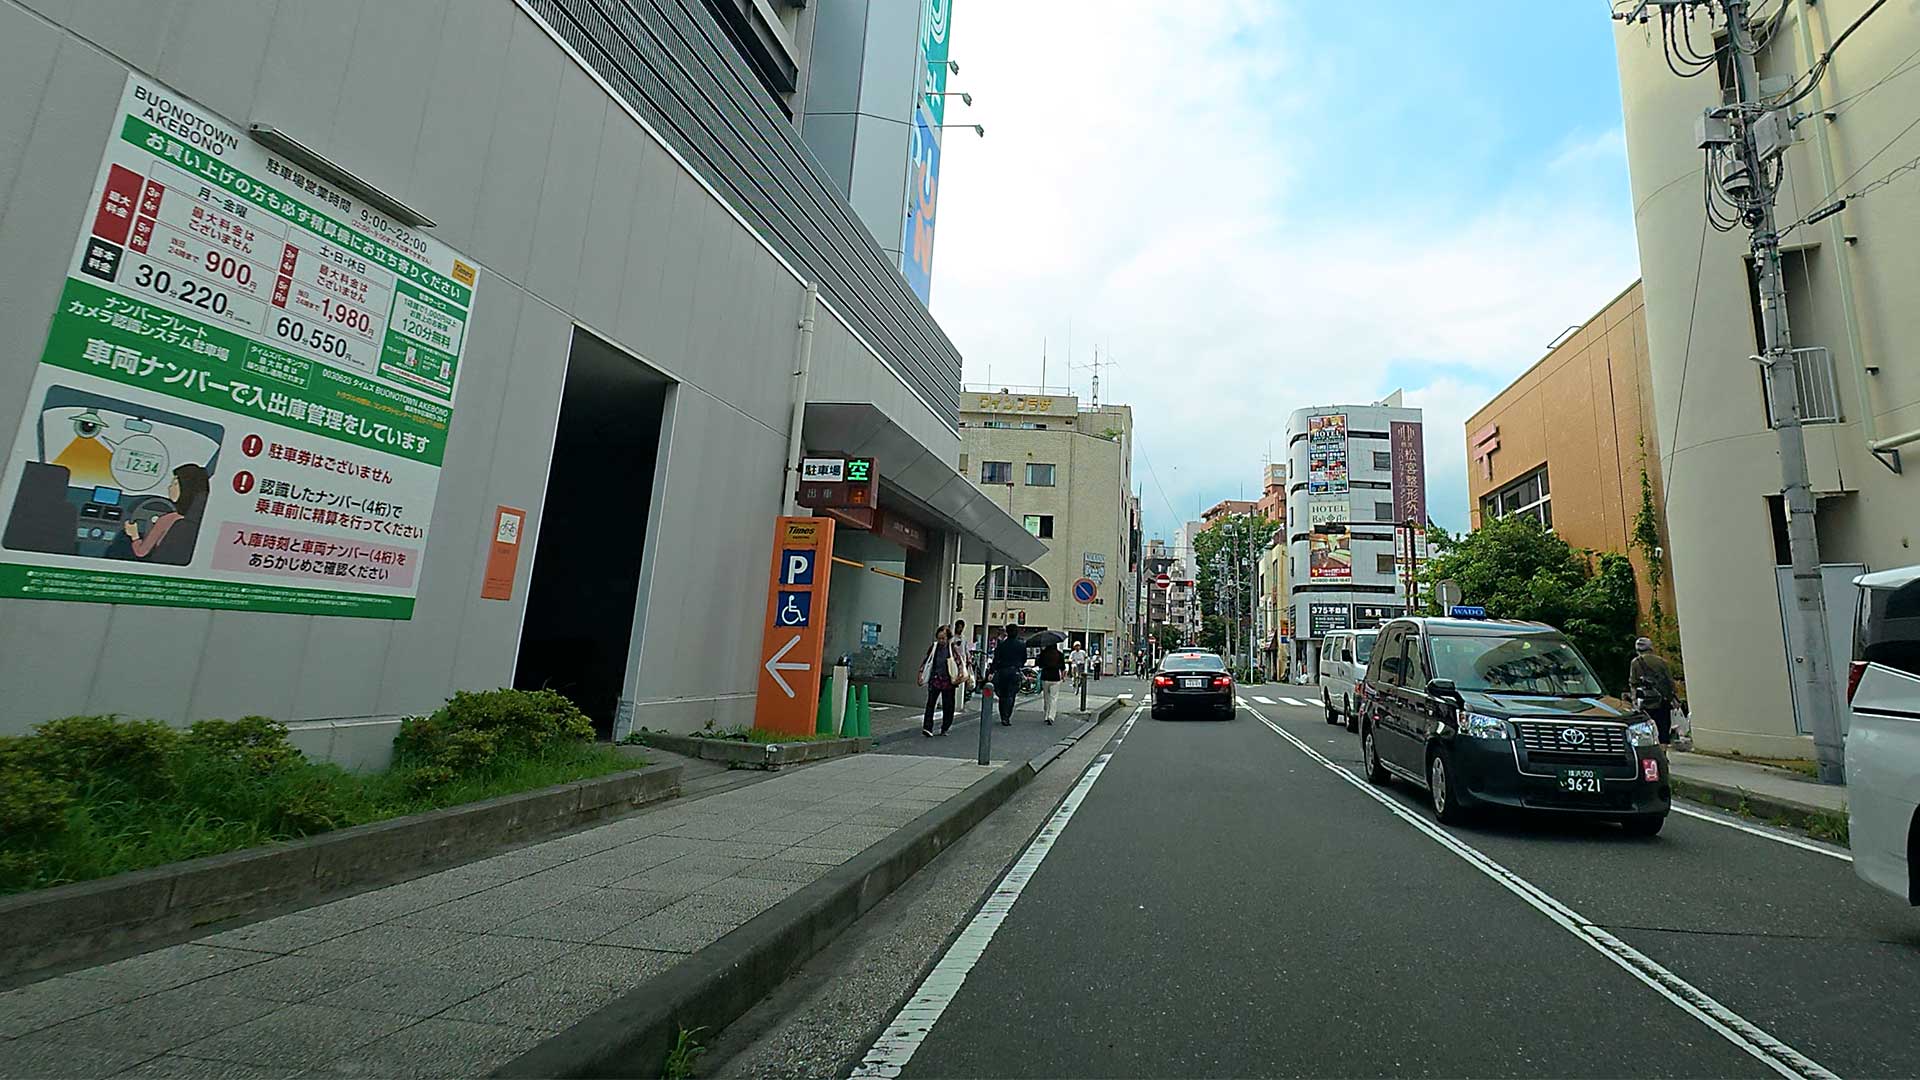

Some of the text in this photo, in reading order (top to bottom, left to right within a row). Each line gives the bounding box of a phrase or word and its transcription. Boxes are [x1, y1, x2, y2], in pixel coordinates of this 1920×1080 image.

[134, 85, 239, 150] BUONOTOWN
[142, 108, 224, 156] AKEBONO
[108, 190, 131, 207] 最大
[146, 186, 161, 198] 3F
[266, 157, 351, 214] 駐車場営業時間
[105, 201, 129, 218] 料金
[145, 132, 460, 298] お買い上げの方も必ず精算機にお立ち寄りください
[192, 206, 255, 241] 最大料金は
[188, 218, 252, 254] ございません
[316, 275, 366, 304] ございません
[319, 263, 369, 293] 最大料金は
[68, 300, 230, 362] カメラ認識システム駐車場
[105, 296, 208, 339] ナンバープレート
[82, 337, 430, 454] 車両ナンバーで入出庫管理をしています
[418, 401, 448, 417] AKEBONO
[267, 443, 393, 484] 駐車券はございません
[804, 459, 870, 481] 駐車場 空
[255, 498, 423, 539] 乗車前に精算を行ってください
[1312, 505, 1347, 513] HOTEL
[788, 525, 815, 535] Times
[249, 553, 389, 581] あらかじめご確認ください
[787, 555, 808, 584] P
[1454, 608, 1484, 617] WADO
